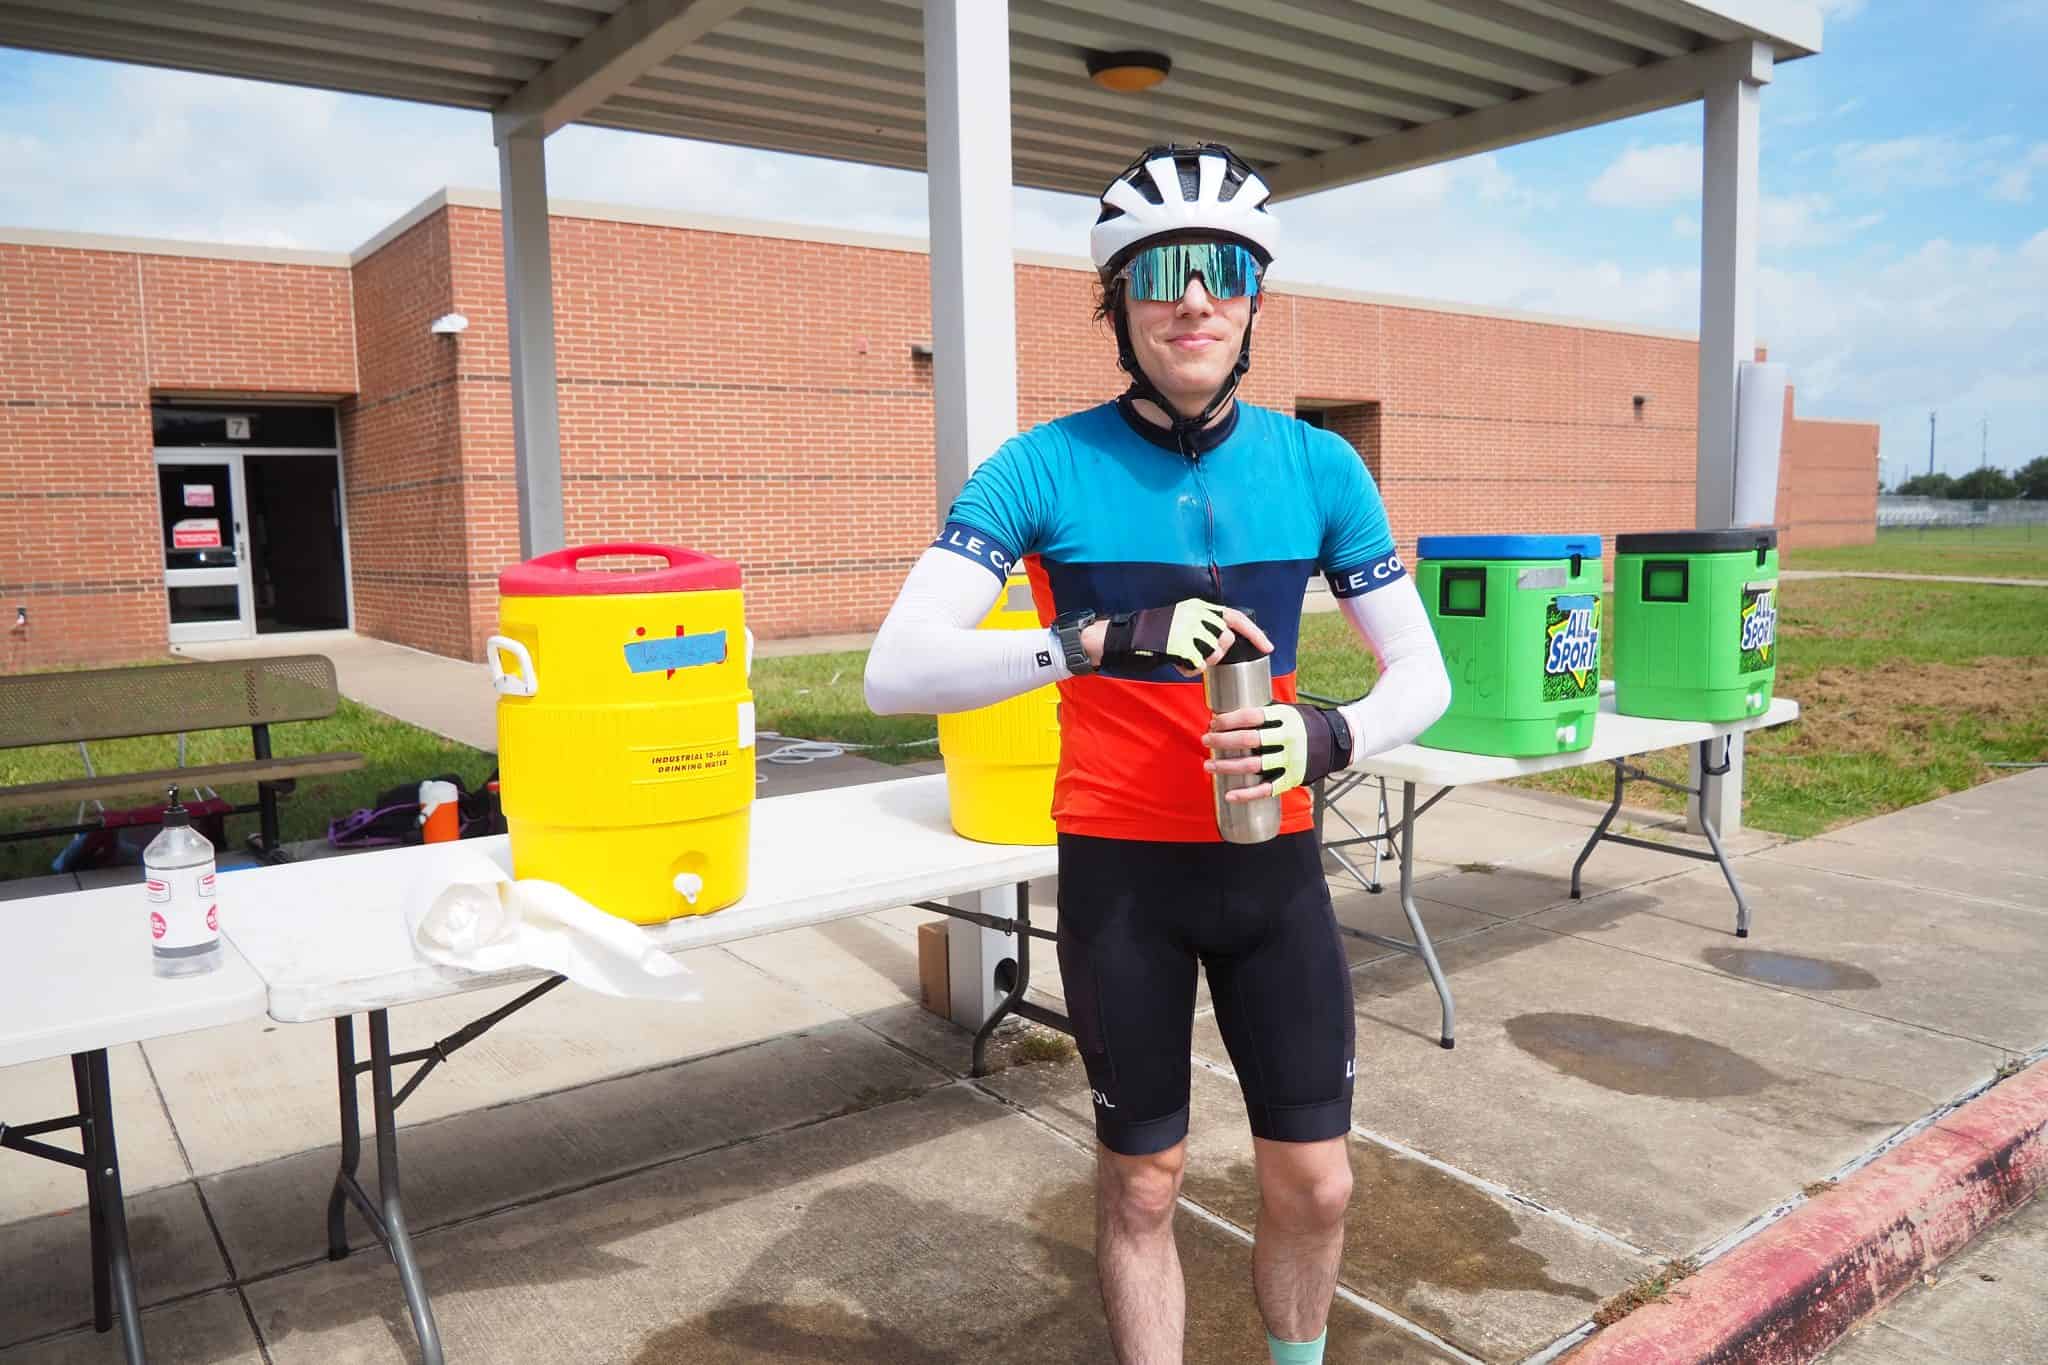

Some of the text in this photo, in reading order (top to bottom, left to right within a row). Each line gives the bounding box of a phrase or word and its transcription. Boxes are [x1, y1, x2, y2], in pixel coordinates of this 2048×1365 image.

[231, 420, 243, 436] 7
[948, 530, 986, 556] LE
[1335, 570, 1369, 593] LE
[1756, 593, 1772, 618] ALL
[1565, 609, 1591, 640] ALL
[1547, 630, 1598, 673] SPORT
[652, 753, 703, 765] INDUSTRIAL
[658, 759, 727, 773] DRINKING WATER
